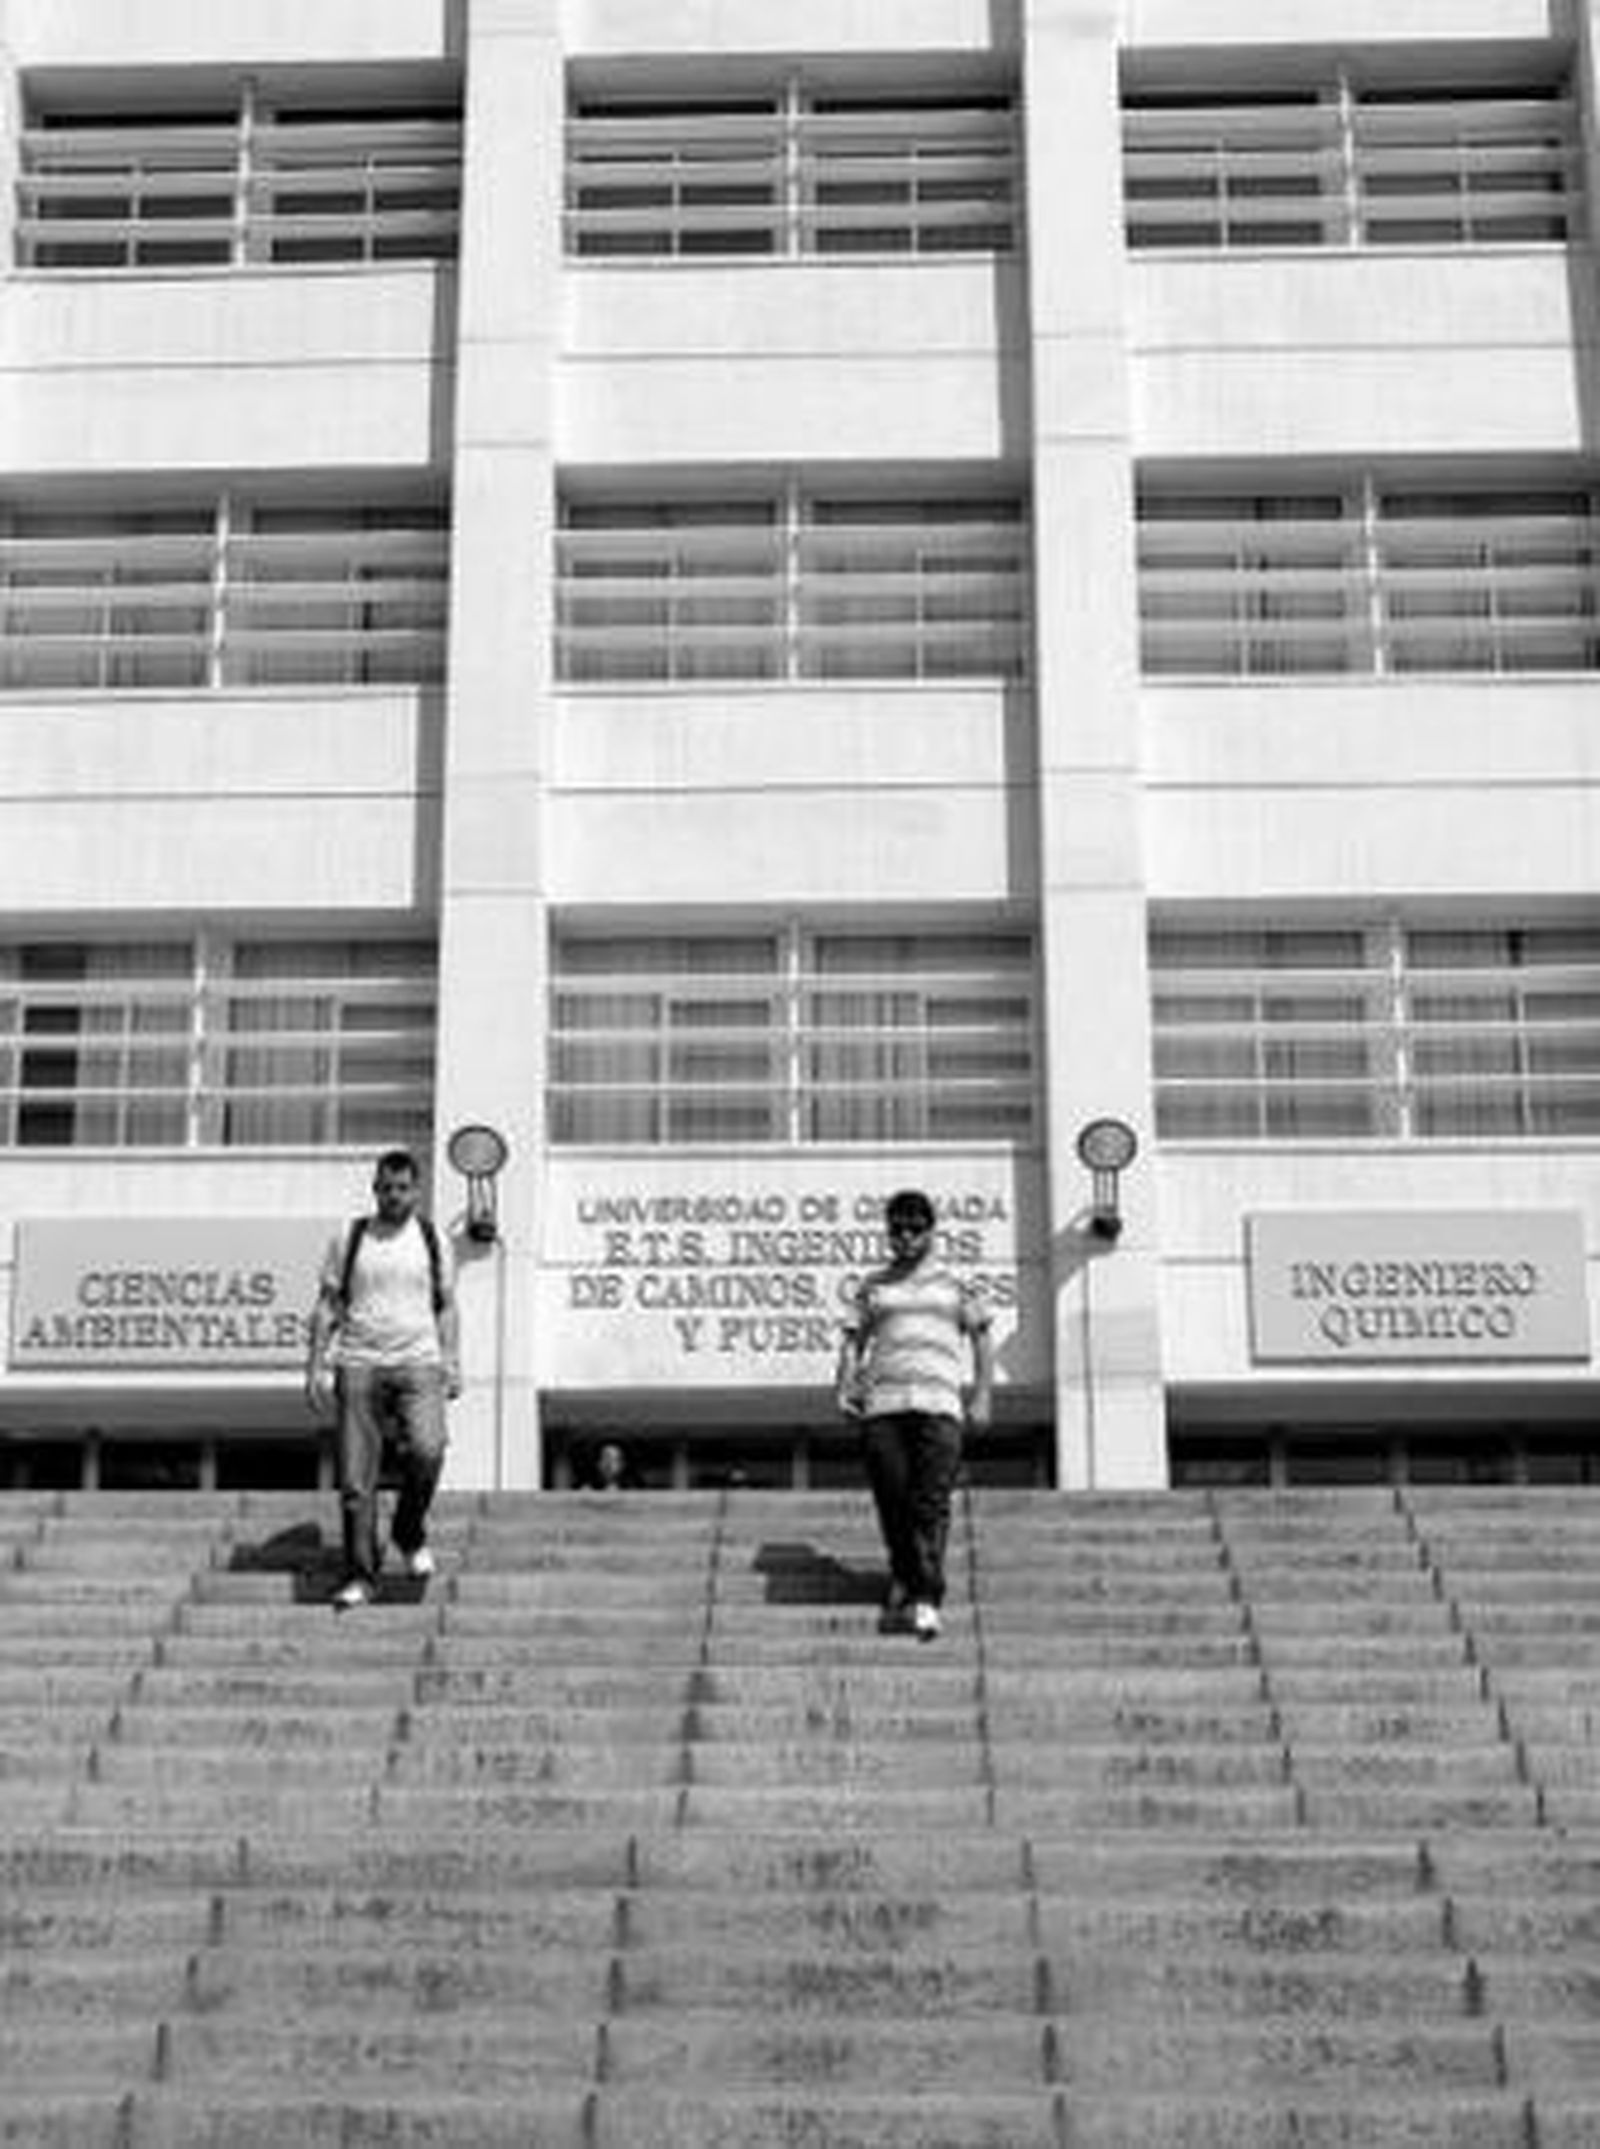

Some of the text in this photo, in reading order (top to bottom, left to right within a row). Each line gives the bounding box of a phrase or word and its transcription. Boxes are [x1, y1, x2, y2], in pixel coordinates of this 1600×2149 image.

[577, 1196, 788, 1224] UNIVERSIDAD
[800, 1196, 838, 1224] DE
[78, 1272, 276, 1306] CIENCIAS
[571, 1273, 624, 1309] DE
[1291, 1260, 1535, 1298] INGENIERO
[674, 1317, 702, 1352] Y
